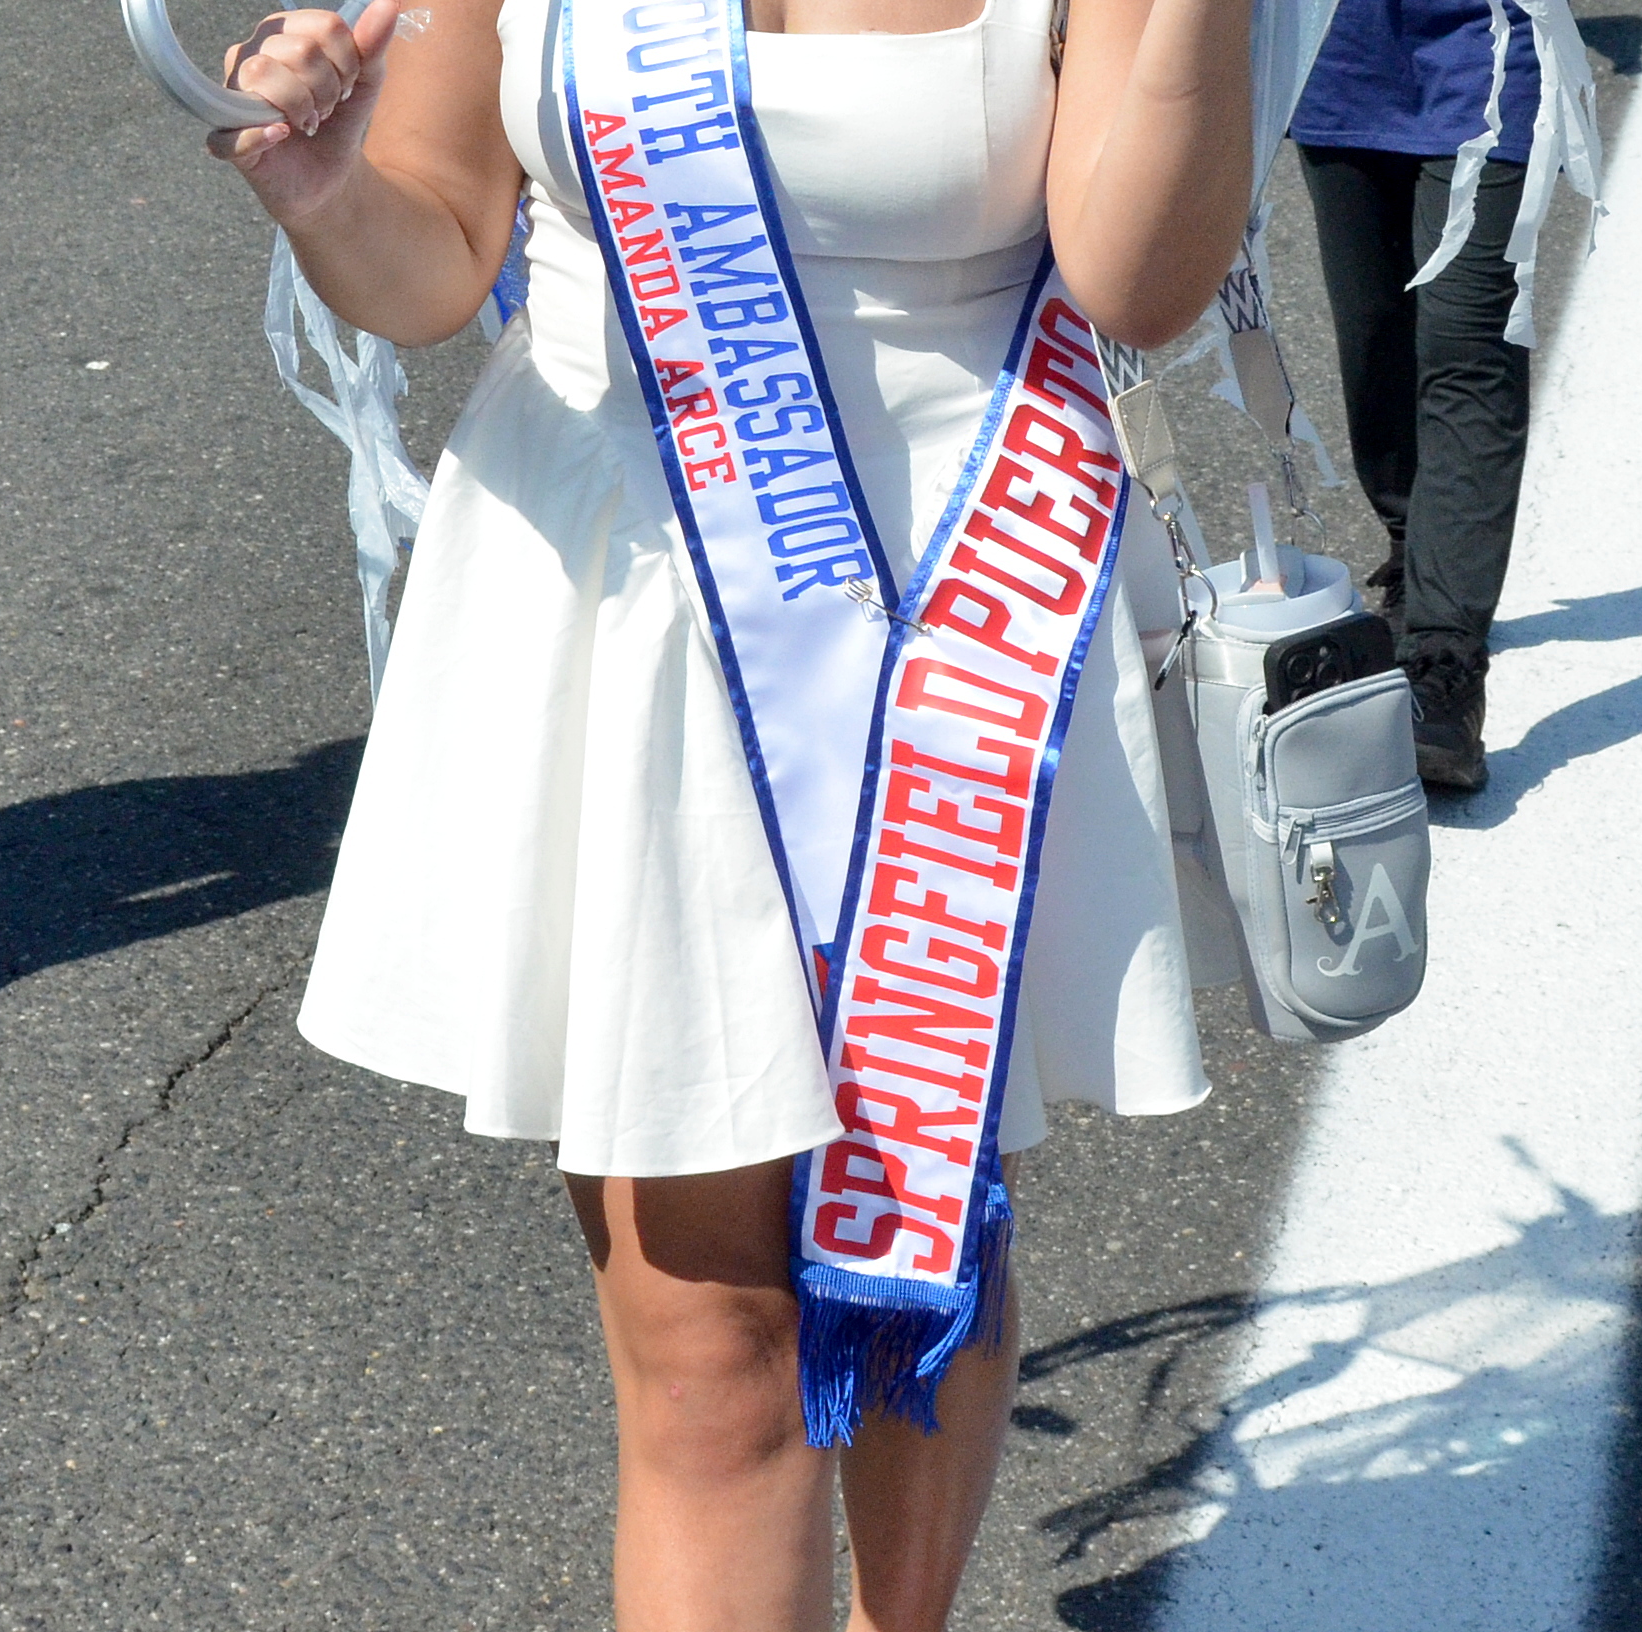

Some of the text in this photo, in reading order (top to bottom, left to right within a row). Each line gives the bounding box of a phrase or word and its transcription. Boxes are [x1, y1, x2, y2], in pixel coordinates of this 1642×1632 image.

[582, 108, 738, 492] AMANDA ARCE
[662, 200, 875, 603] AMBASSADOR
[812, 655, 1052, 1276] SPRINGFIELD
[1316, 862, 1421, 977] A
